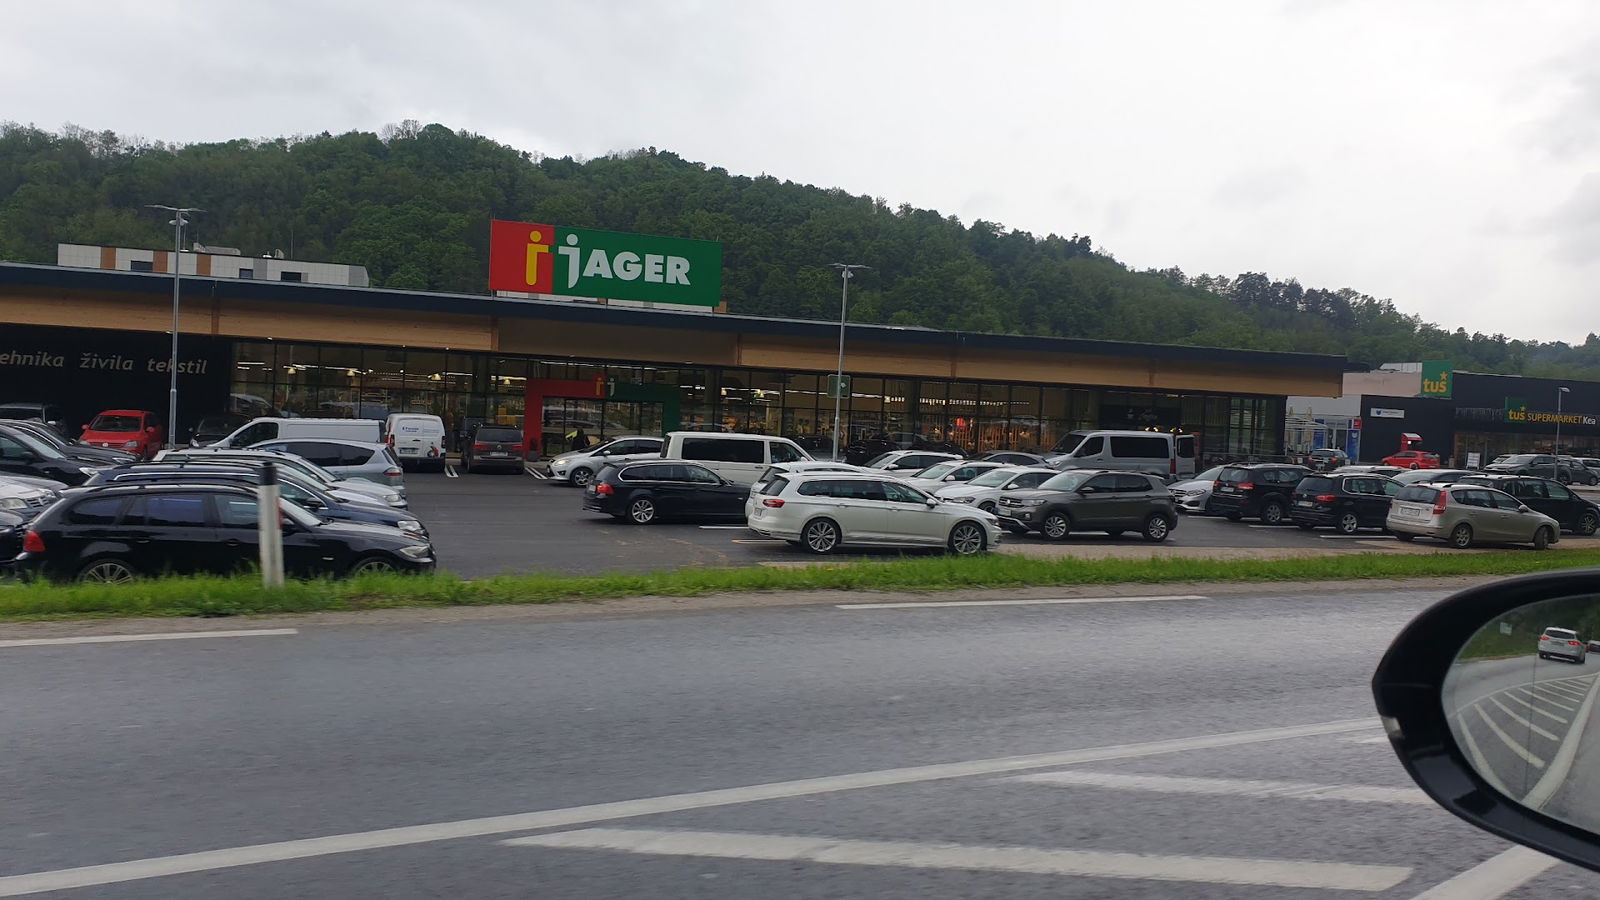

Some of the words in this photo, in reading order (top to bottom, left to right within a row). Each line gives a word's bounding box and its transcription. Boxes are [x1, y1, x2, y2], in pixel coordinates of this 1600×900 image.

[80, 352, 134, 371] živila
[147, 358, 208, 374] tekstil
[1527, 413, 1583, 424] SUPERMARKET
